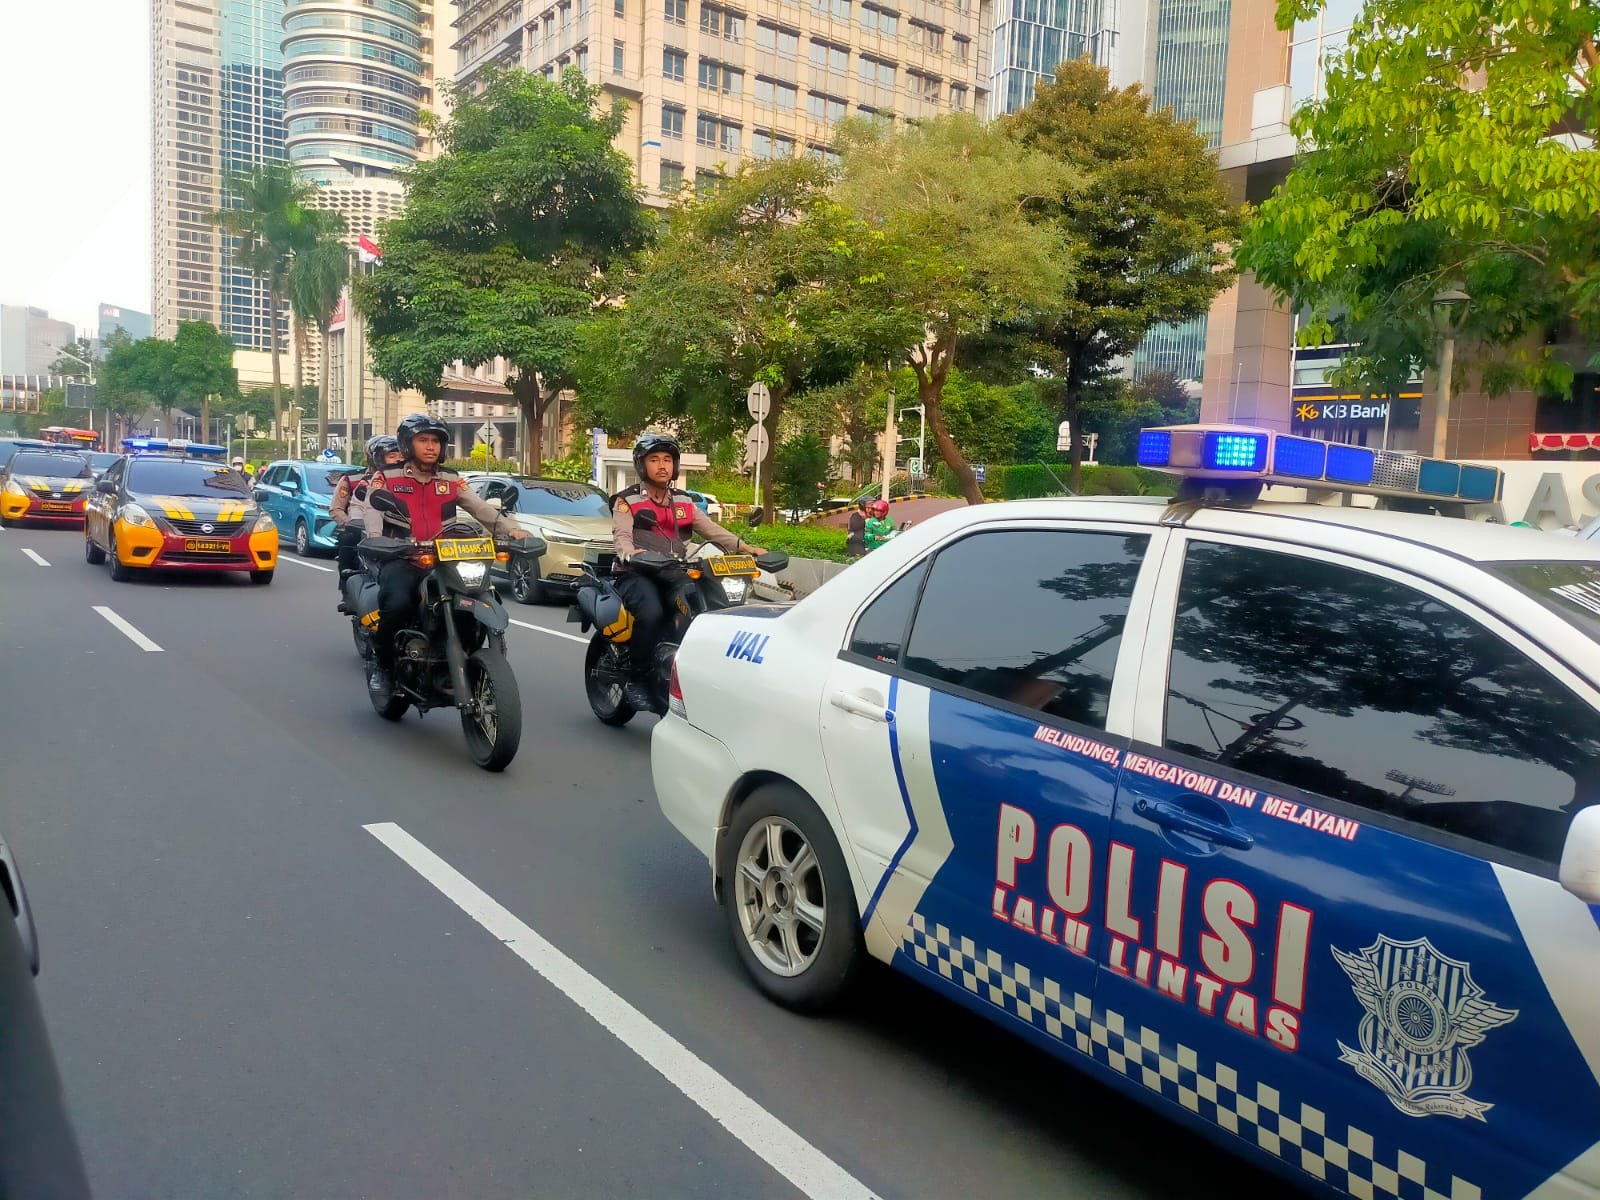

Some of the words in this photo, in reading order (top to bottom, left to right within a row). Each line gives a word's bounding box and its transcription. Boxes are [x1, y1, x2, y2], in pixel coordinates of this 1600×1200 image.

[1322, 404, 1347, 419] KB
[1350, 402, 1387, 420] Bank
[725, 630, 771, 665] WAL
[1033, 724, 1121, 768] MELINDUNGI,
[1123, 752, 1217, 797] MENGAYOMI
[1217, 781, 1257, 810] DAN
[1260, 793, 1360, 842] MELAYANI
[995, 801, 1314, 1013] POLISI
[992, 886, 1092, 956] LALU
[1108, 938, 1301, 1053] LINTAS
[1398, 981, 1437, 1003] POLISI
